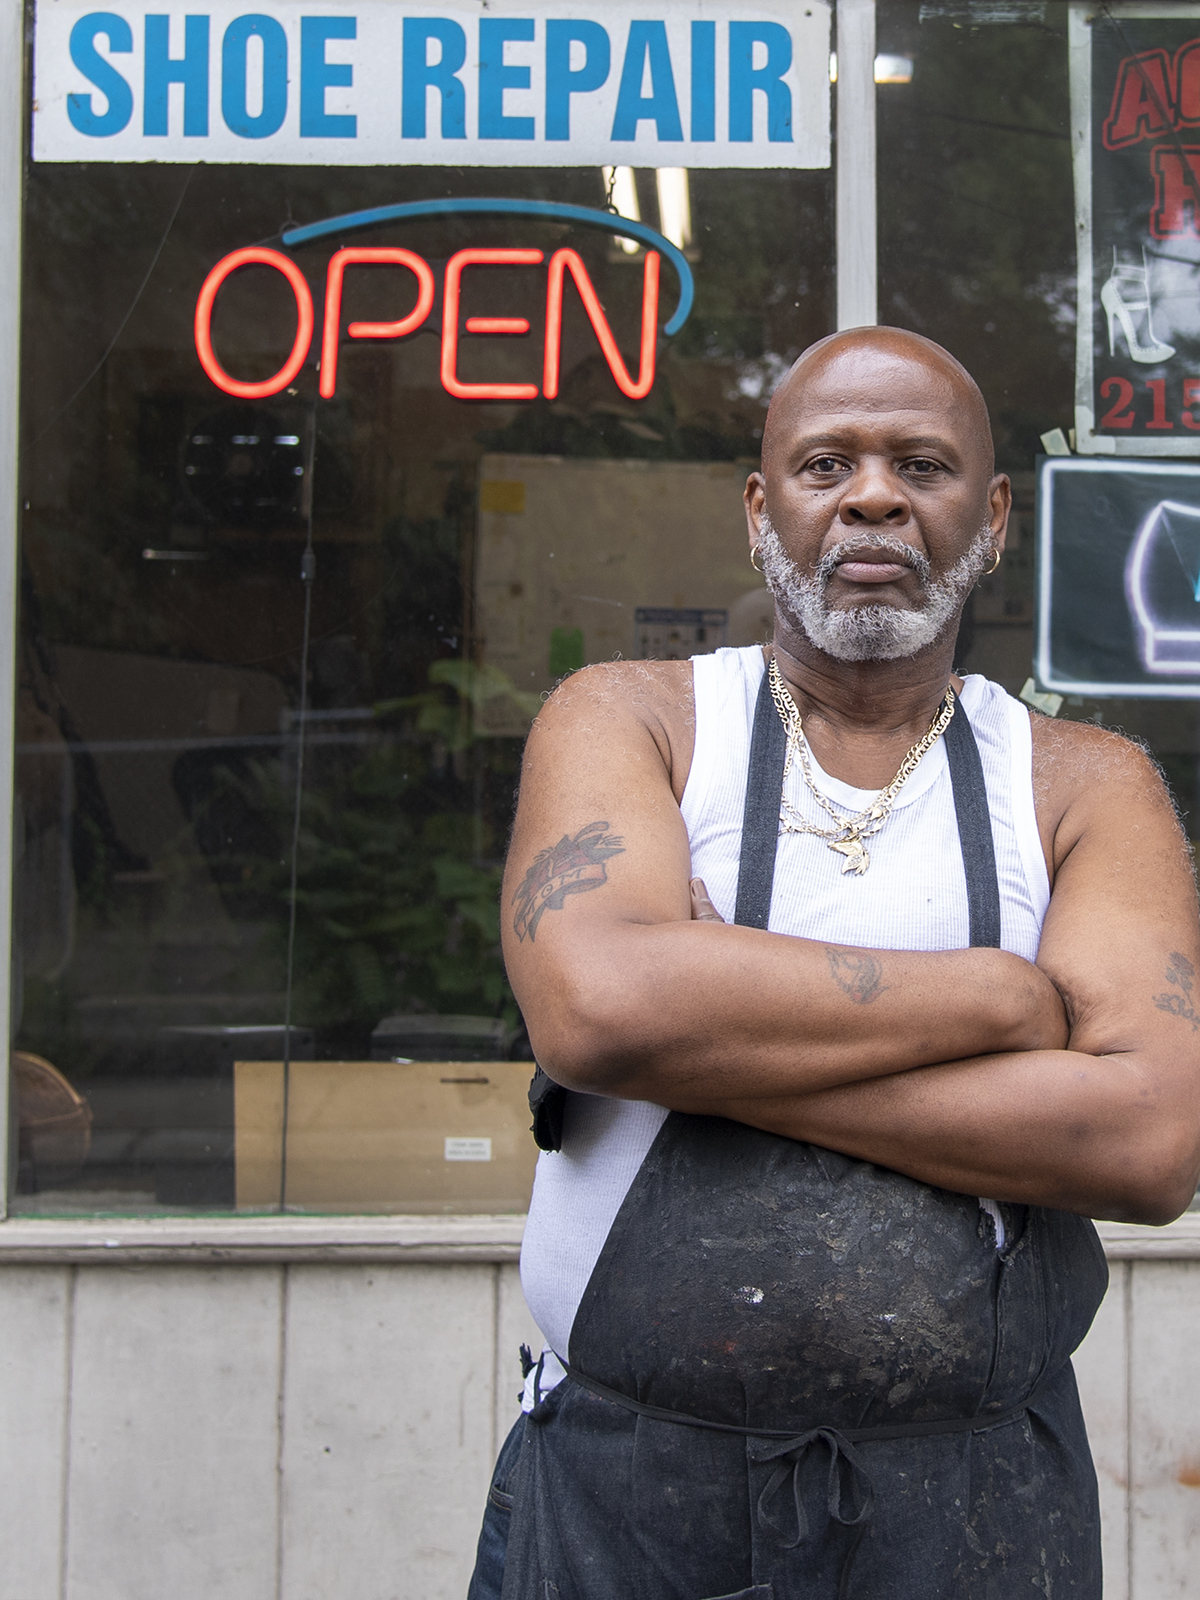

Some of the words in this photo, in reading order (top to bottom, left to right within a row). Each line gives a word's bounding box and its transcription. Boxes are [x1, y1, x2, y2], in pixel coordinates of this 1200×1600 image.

[67, 12, 358, 139] SHOE
[401, 17, 794, 143] REPAIR
[194, 247, 660, 400] OPEN
